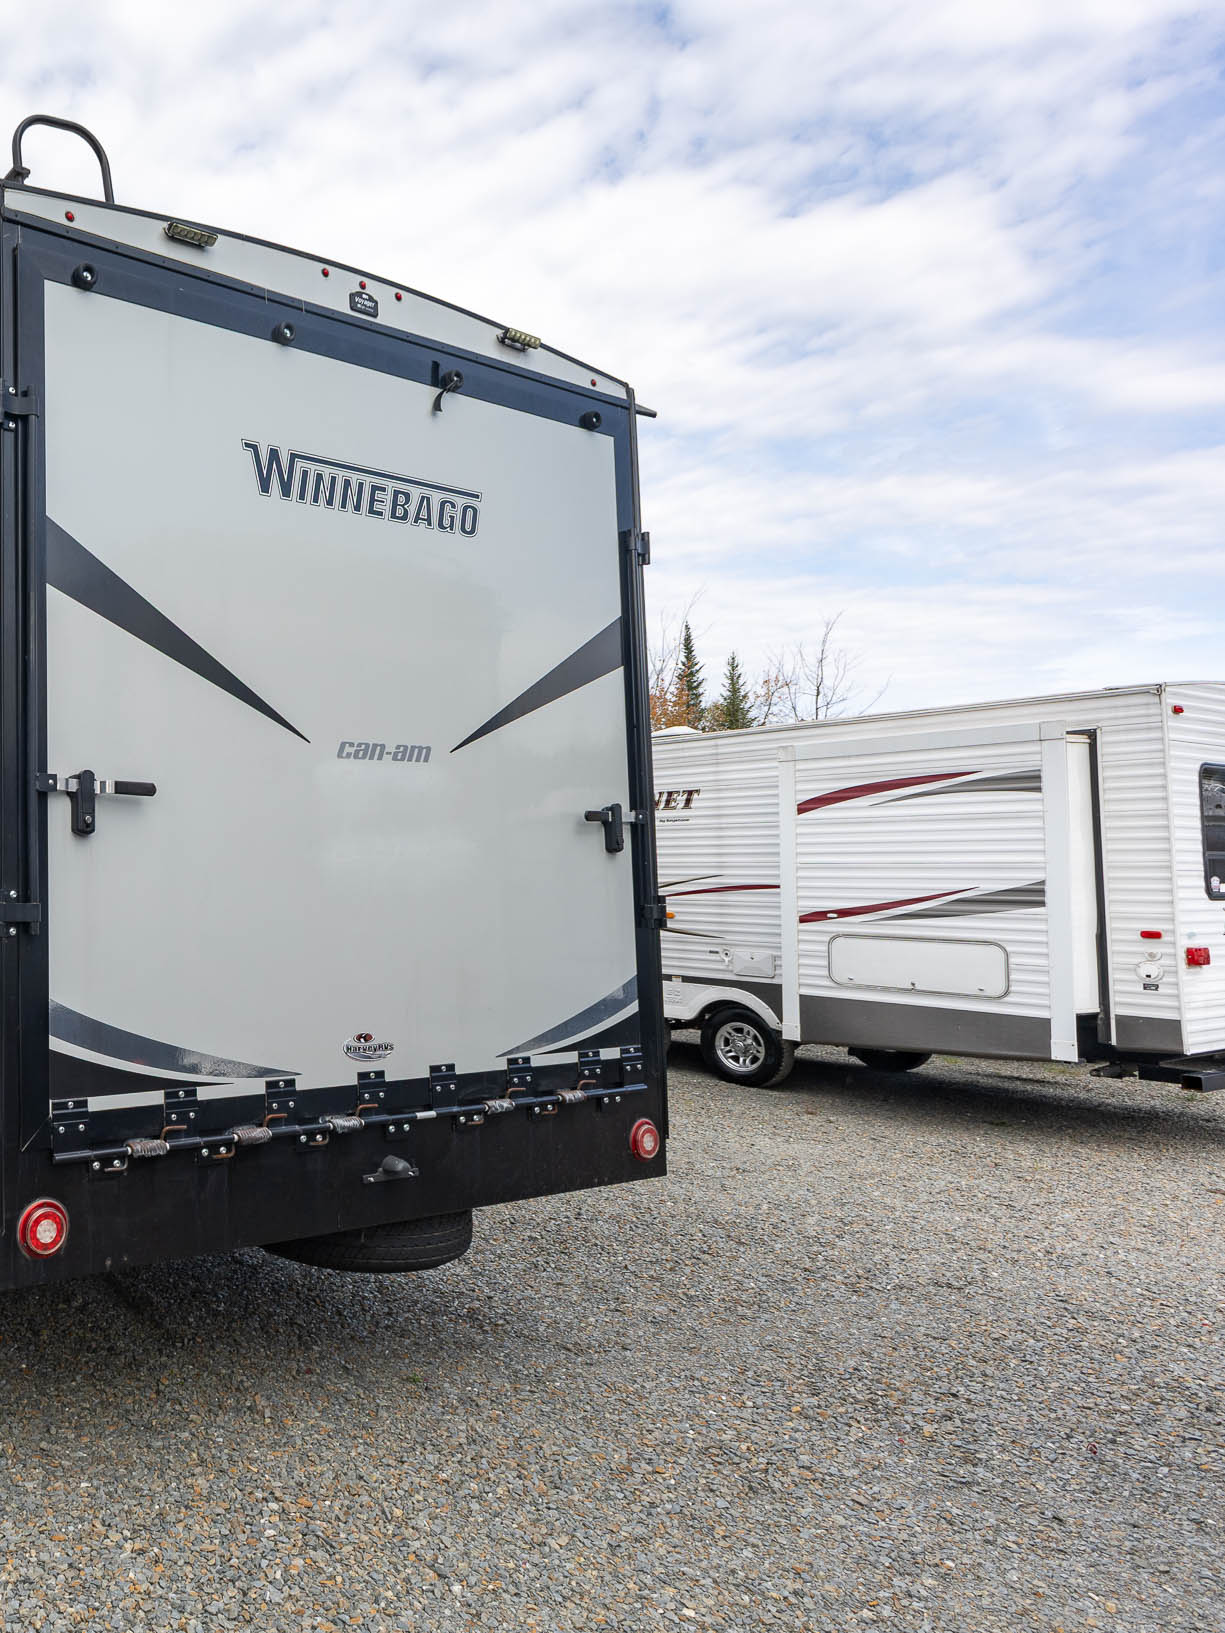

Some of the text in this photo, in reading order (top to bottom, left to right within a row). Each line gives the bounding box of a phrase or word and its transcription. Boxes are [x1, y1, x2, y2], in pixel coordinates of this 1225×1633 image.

[355, 296, 376, 308] Voyager
[241, 439, 482, 537] WINNEBAGO
[337, 741, 432, 763] can-am
